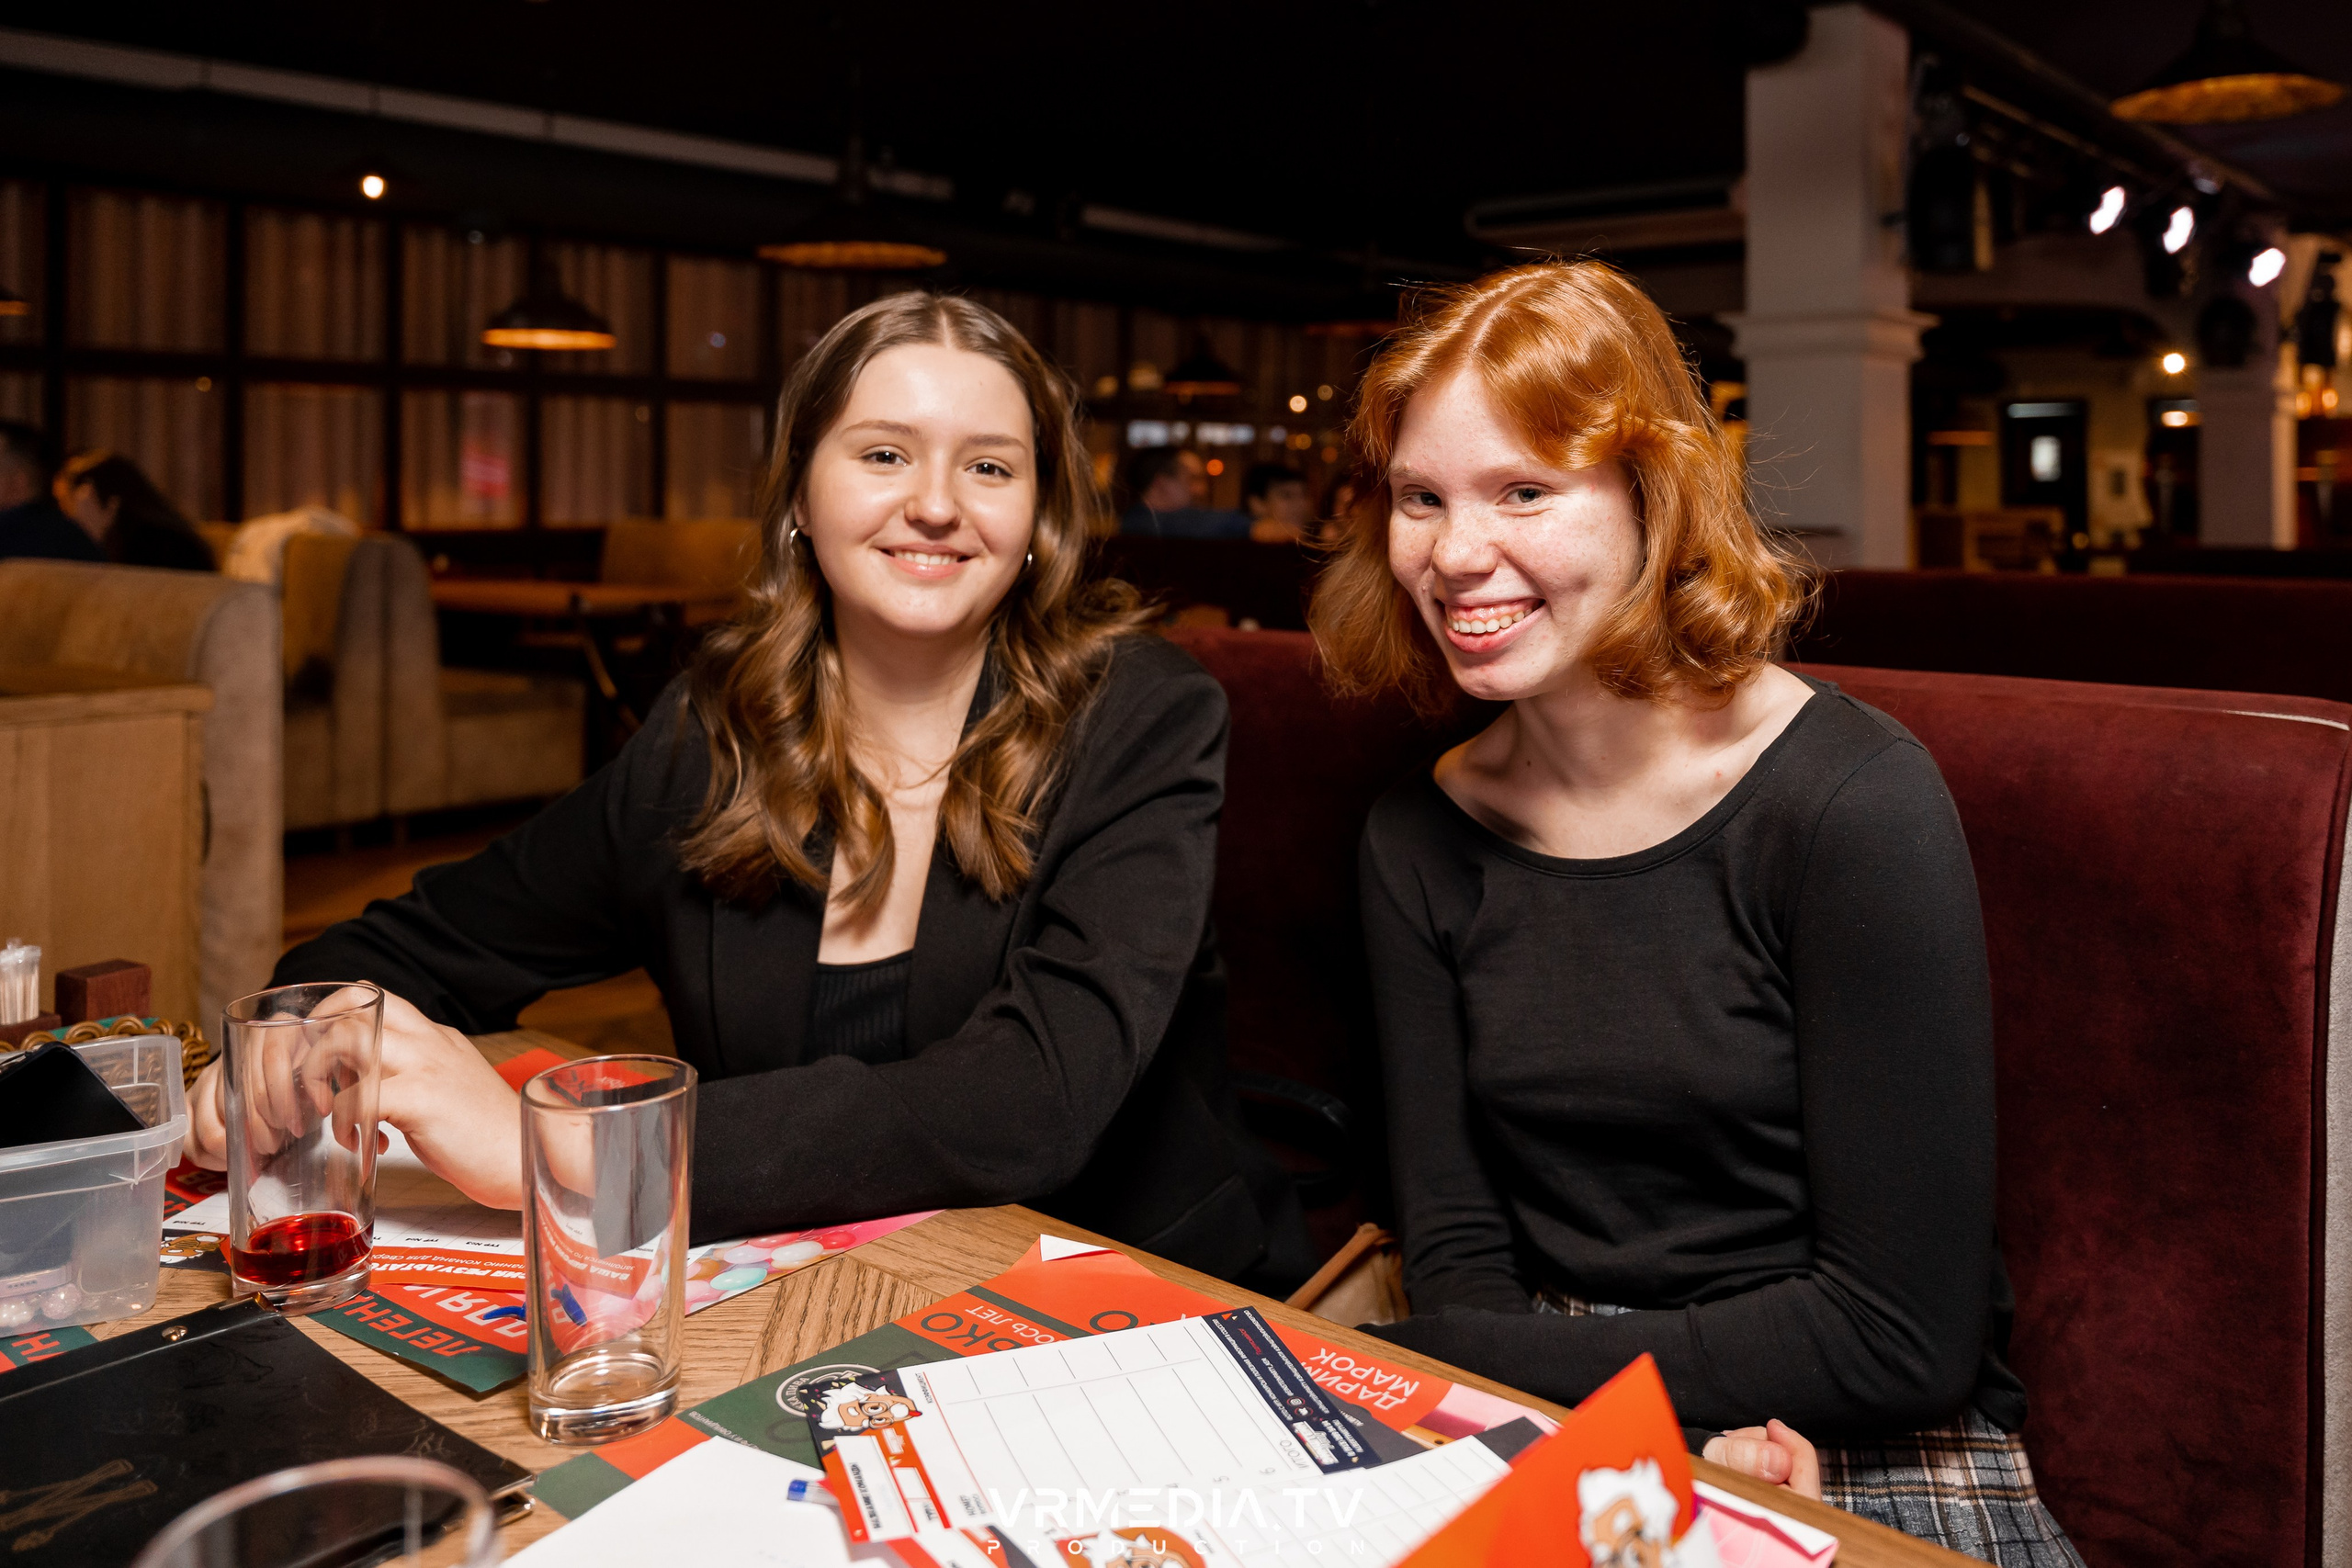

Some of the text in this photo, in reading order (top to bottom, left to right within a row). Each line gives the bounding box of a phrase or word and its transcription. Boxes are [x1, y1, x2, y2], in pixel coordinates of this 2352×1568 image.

[370, 1261, 492, 1277] РЕЗУЛЬТАТО
[920, 1311, 1024, 1352] ЬКО
[965, 1304, 1057, 1346] ОСЬ ЛЕТ
[1300, 1361, 1408, 1411] ДАРИМ
[1308, 1348, 1420, 1398] МАРОК
